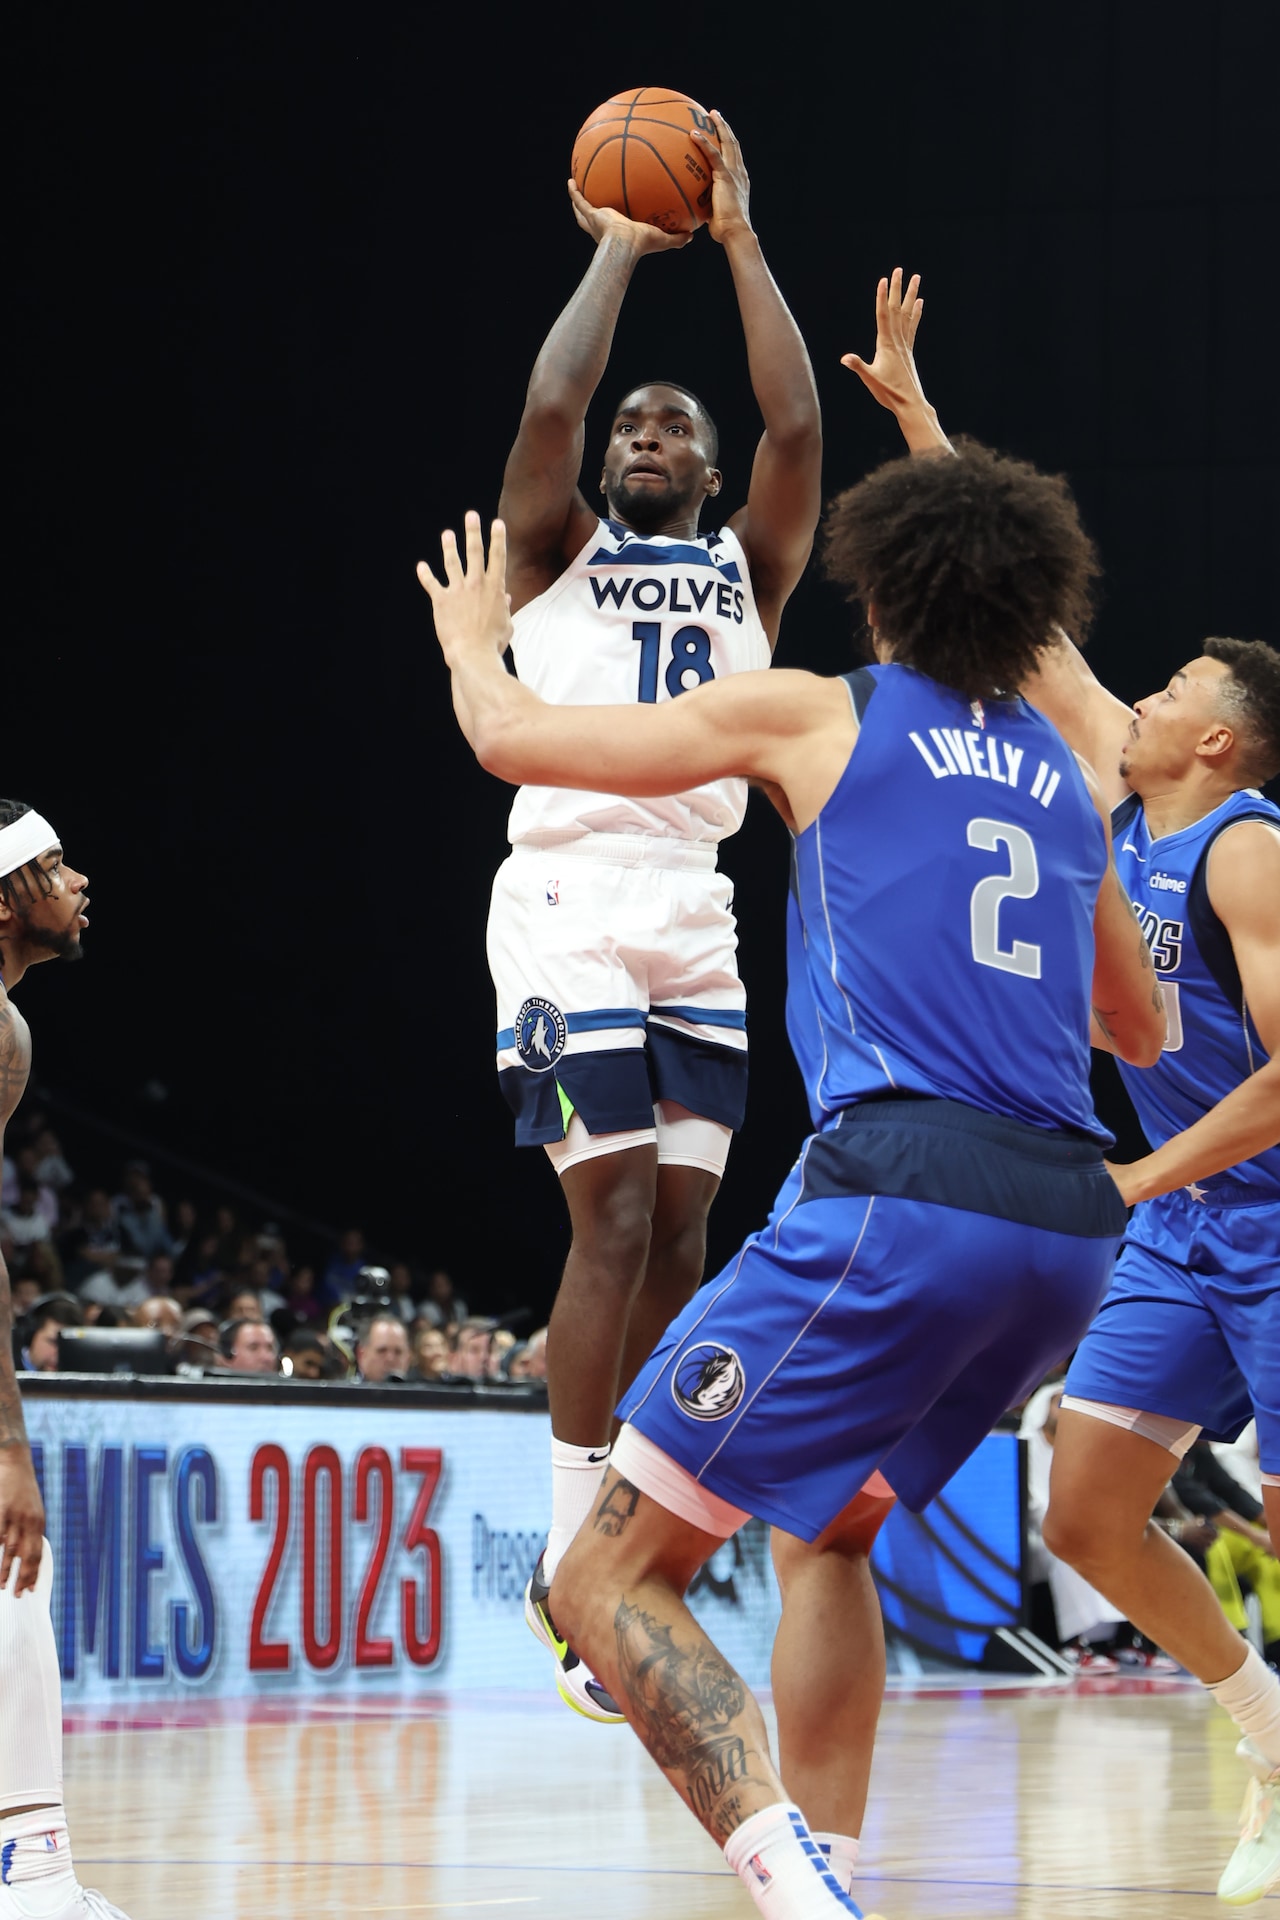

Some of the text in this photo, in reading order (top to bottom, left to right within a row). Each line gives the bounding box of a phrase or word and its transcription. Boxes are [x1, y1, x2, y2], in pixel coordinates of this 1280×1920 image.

[589, 576, 744, 624] WOLVES
[632, 621, 716, 704] 18
[908, 728, 1061, 809] LIVELY II
[966, 817, 1041, 979] 2
[1150, 872, 1187, 894] chime
[532, 999, 565, 1054] TIMBERWOLVES
[30, 1440, 443, 1682] MES 2023
